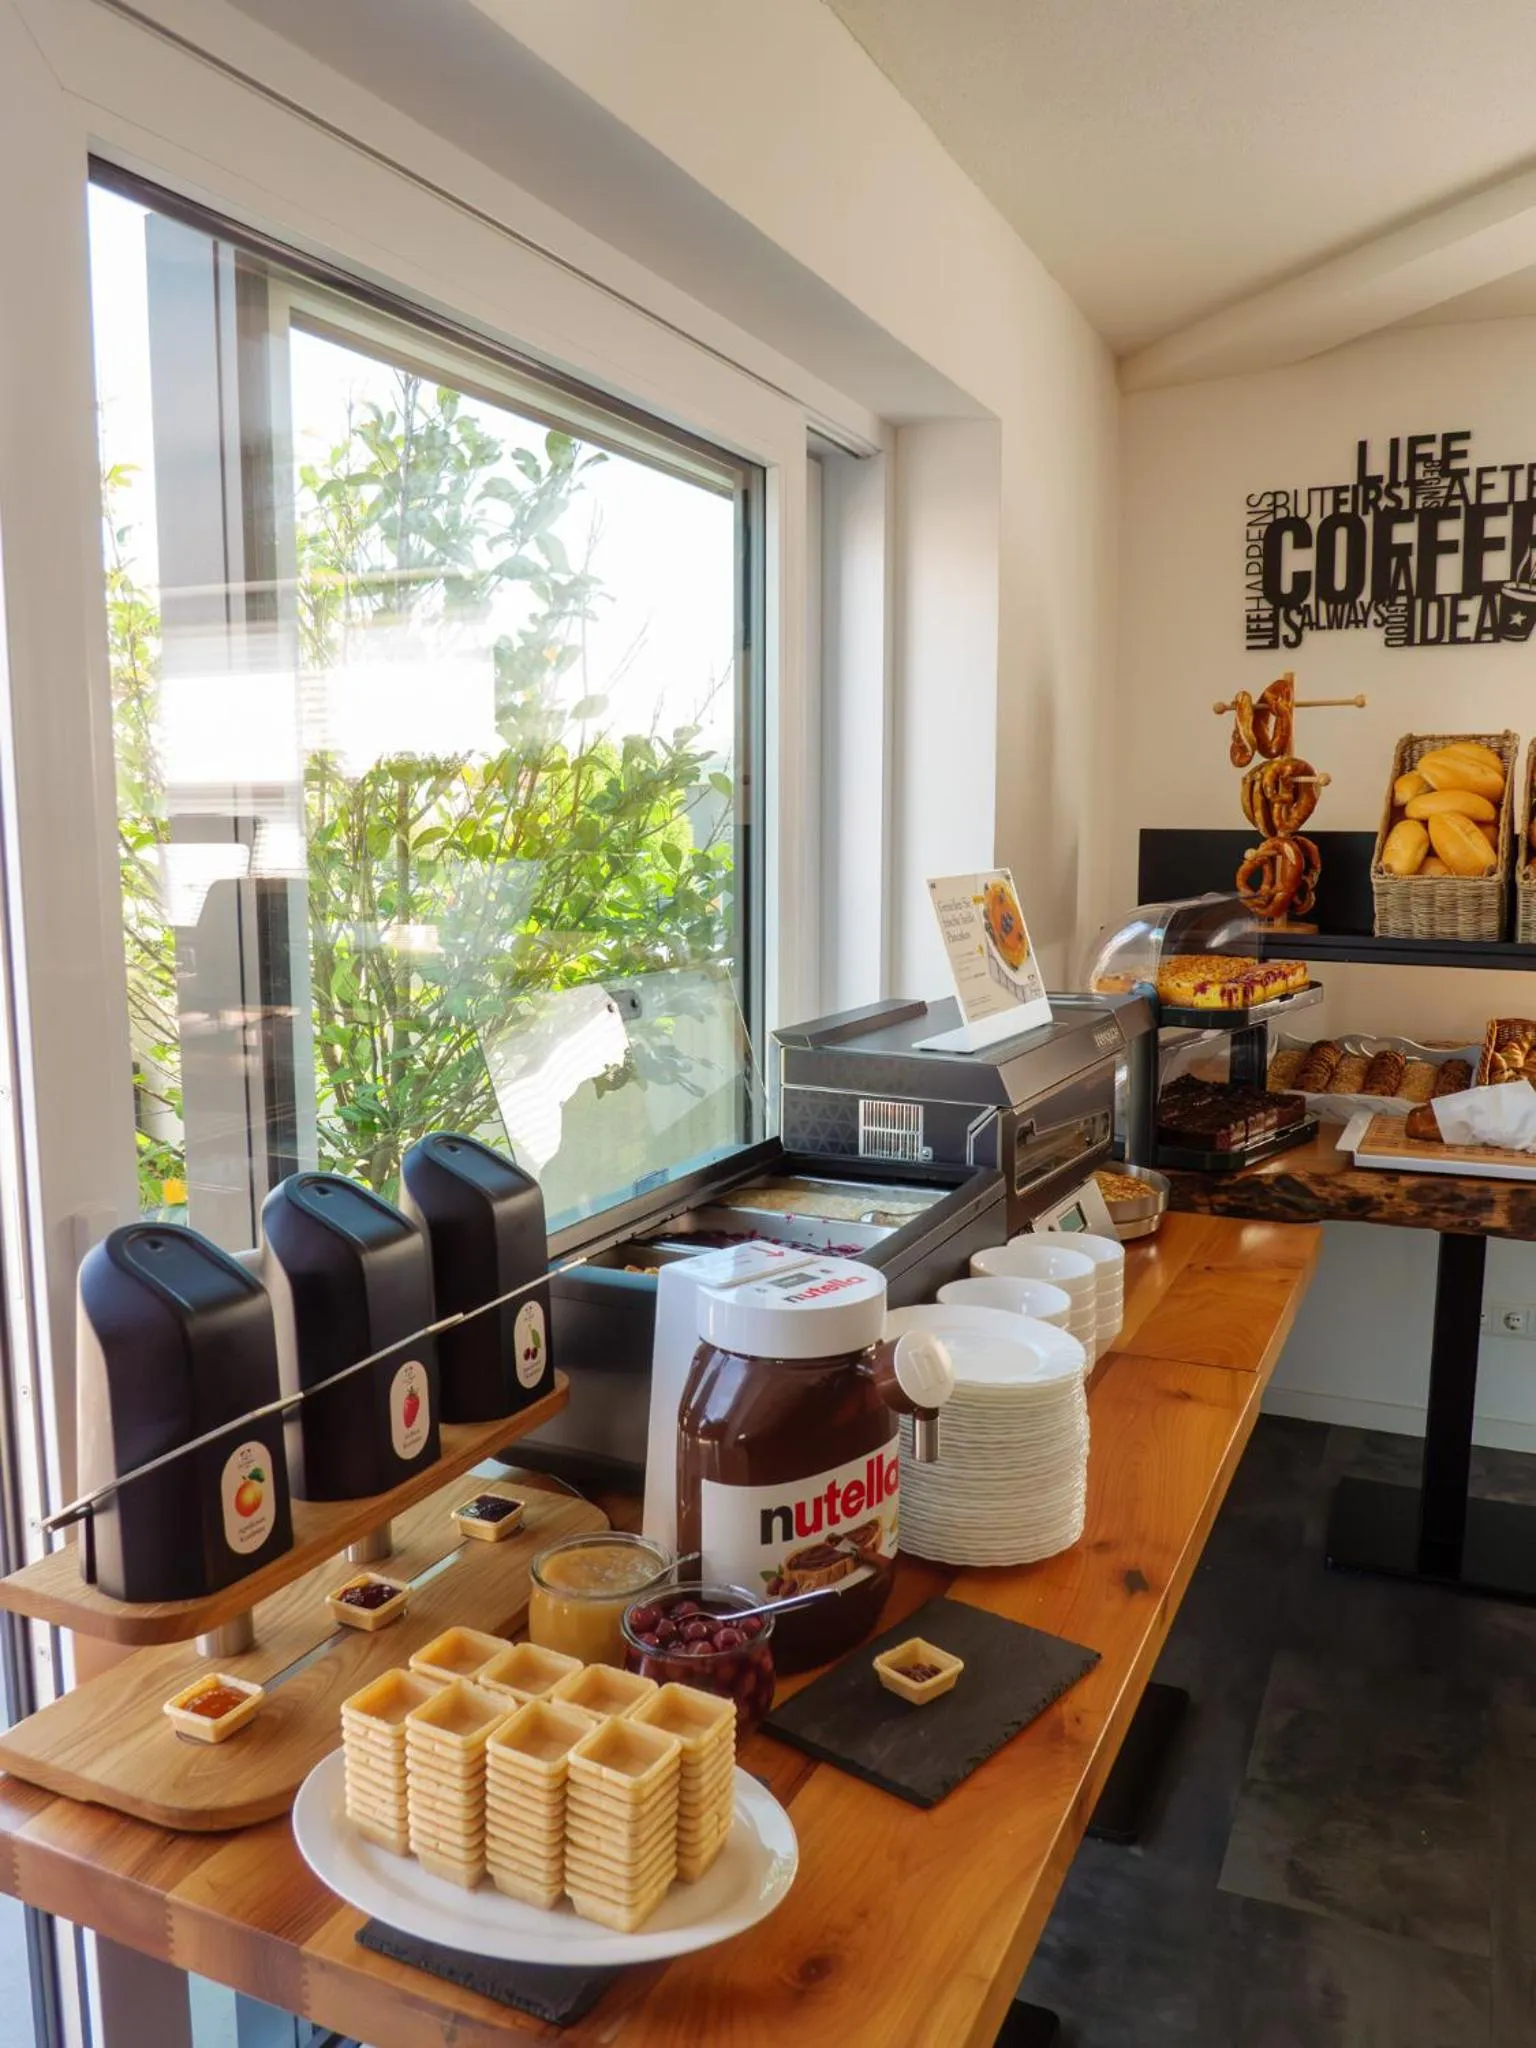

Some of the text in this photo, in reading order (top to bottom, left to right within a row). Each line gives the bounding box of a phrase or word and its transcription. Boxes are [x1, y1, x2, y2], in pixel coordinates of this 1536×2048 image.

[1357, 430, 1472, 486] LIFE
[1272, 479, 1423, 520] BUT FIRST
[1421, 459, 1443, 509] BEGINS
[1245, 490, 1276, 650] LIFE HAPPENS
[1273, 600, 1387, 649] IS ALWAYS
[1384, 603, 1409, 648] GOOD
[1407, 594, 1502, 646] IDEA
[782, 1275, 867, 1304] nutella
[760, 1453, 899, 1546] nutella
